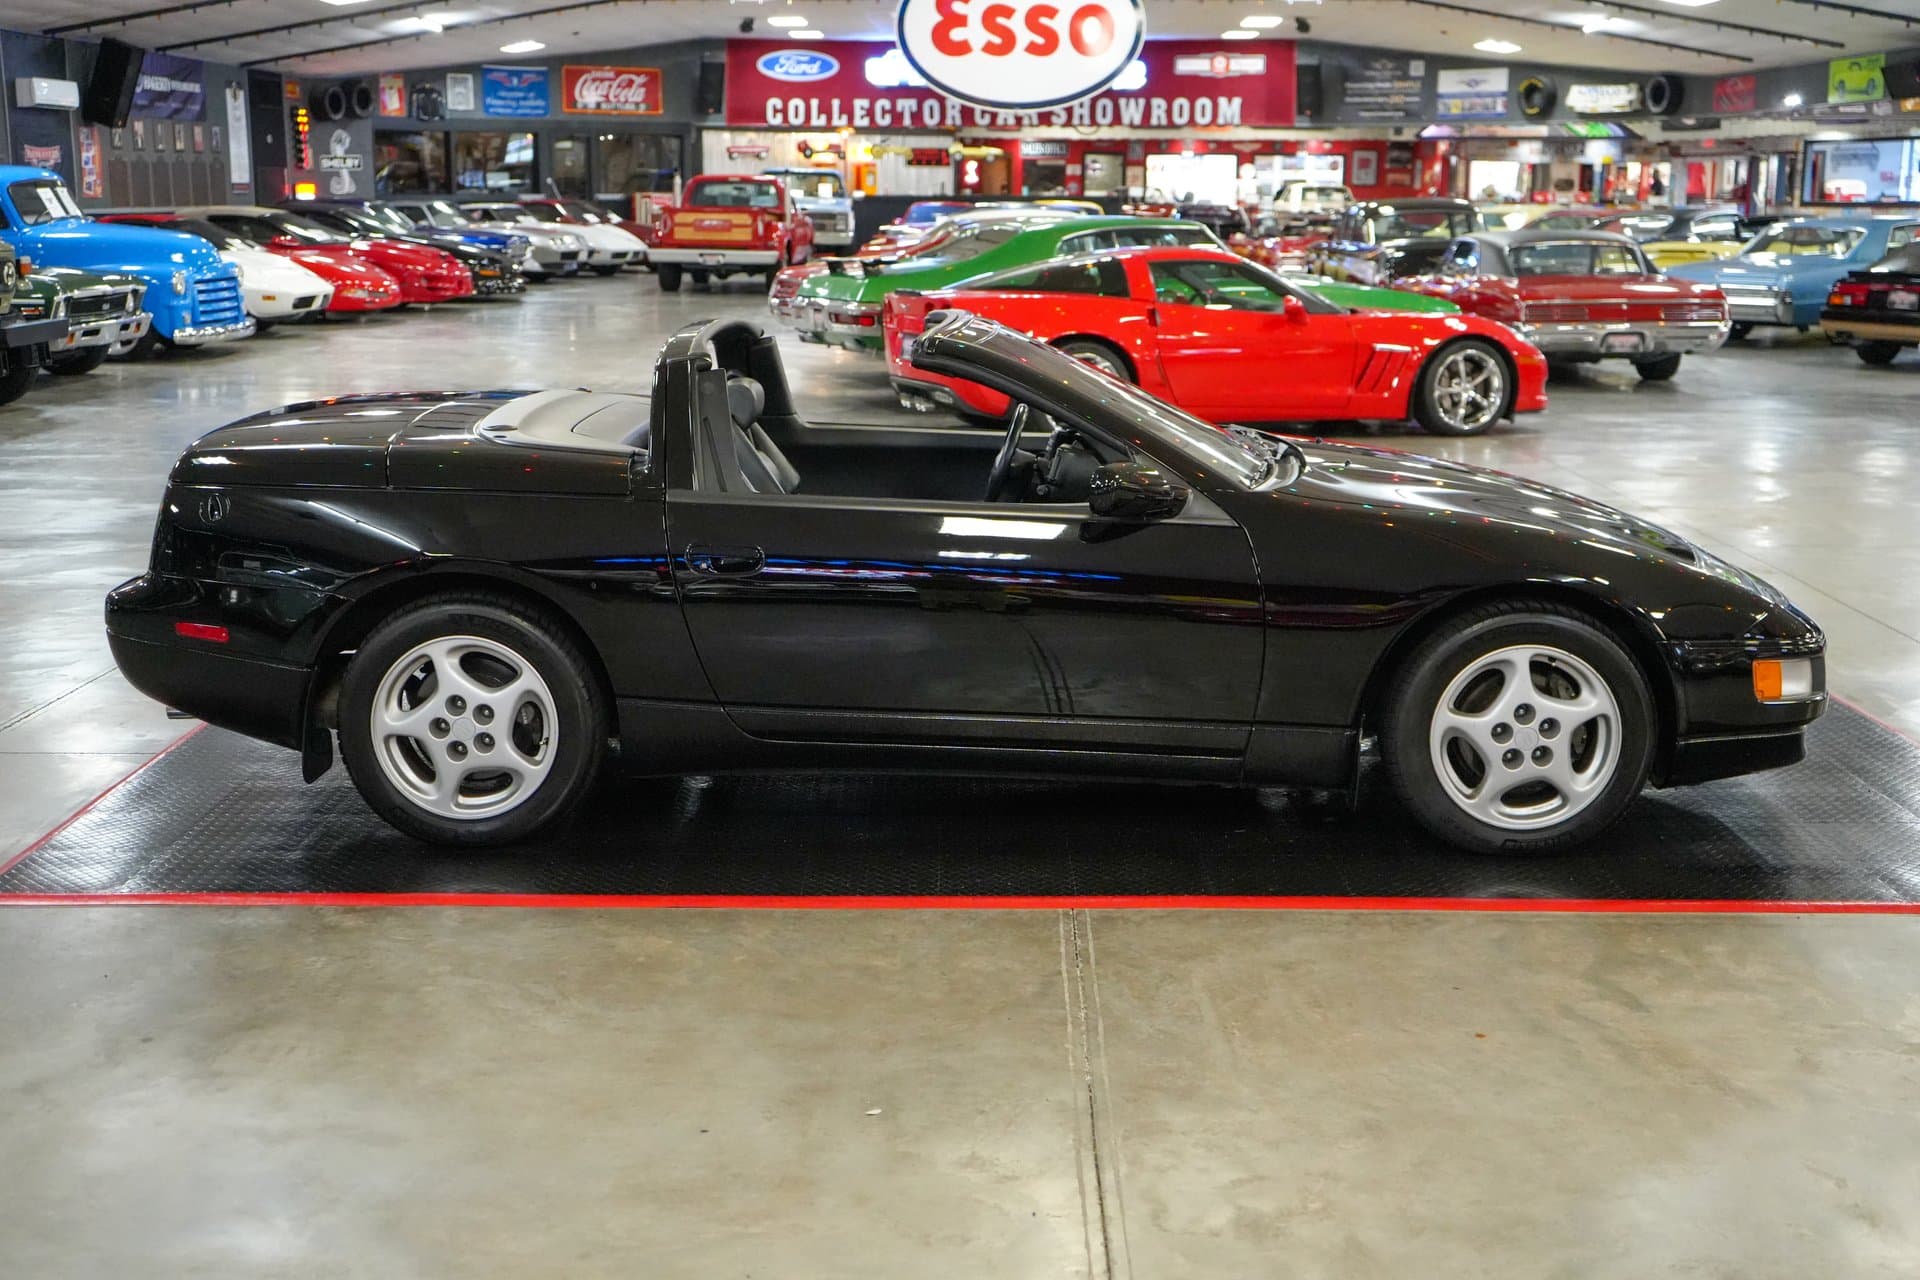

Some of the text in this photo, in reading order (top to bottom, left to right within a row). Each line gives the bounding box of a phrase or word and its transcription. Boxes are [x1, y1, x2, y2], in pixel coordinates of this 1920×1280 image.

[774, 55, 822, 74] Ford
[765, 97, 963, 127] COLLECTOR
[1051, 96, 1243, 127] SHOWROOM
